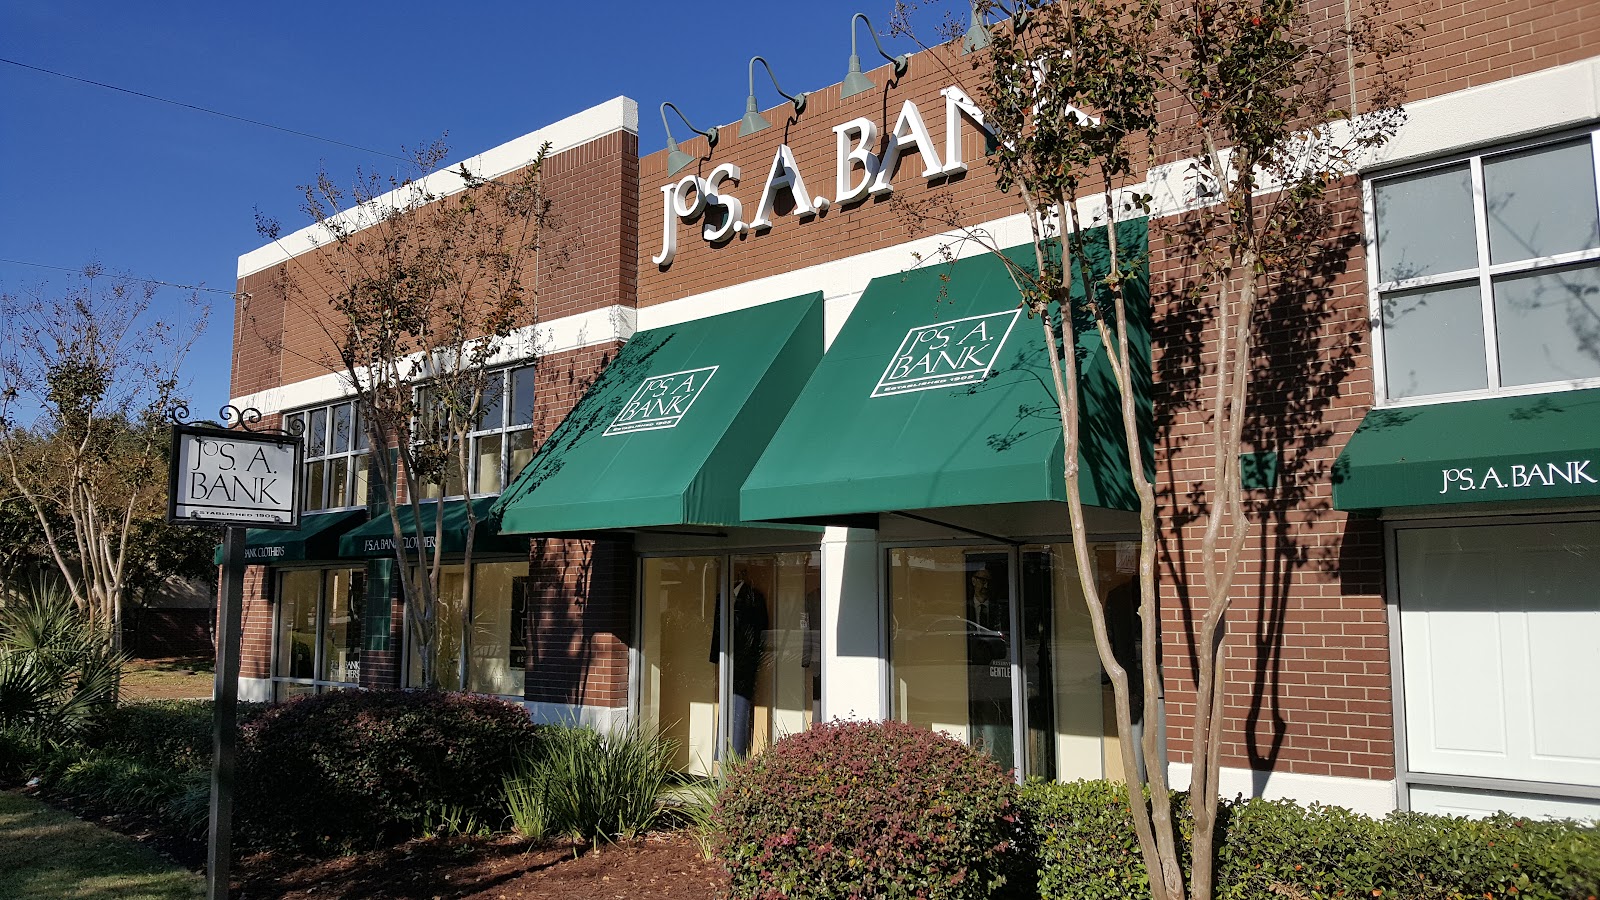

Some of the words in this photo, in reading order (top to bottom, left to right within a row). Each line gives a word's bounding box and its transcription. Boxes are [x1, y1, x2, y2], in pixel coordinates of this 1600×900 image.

[888, 343, 991, 380] BANK
[619, 394, 691, 421] BANK
[1510, 460, 1599, 488] BANK
[190, 471, 281, 505] BANK
[257, 545, 285, 558] CLOTHIERS
[380, 538, 397, 550] BAN
[402, 536, 438, 549] LOTIER
